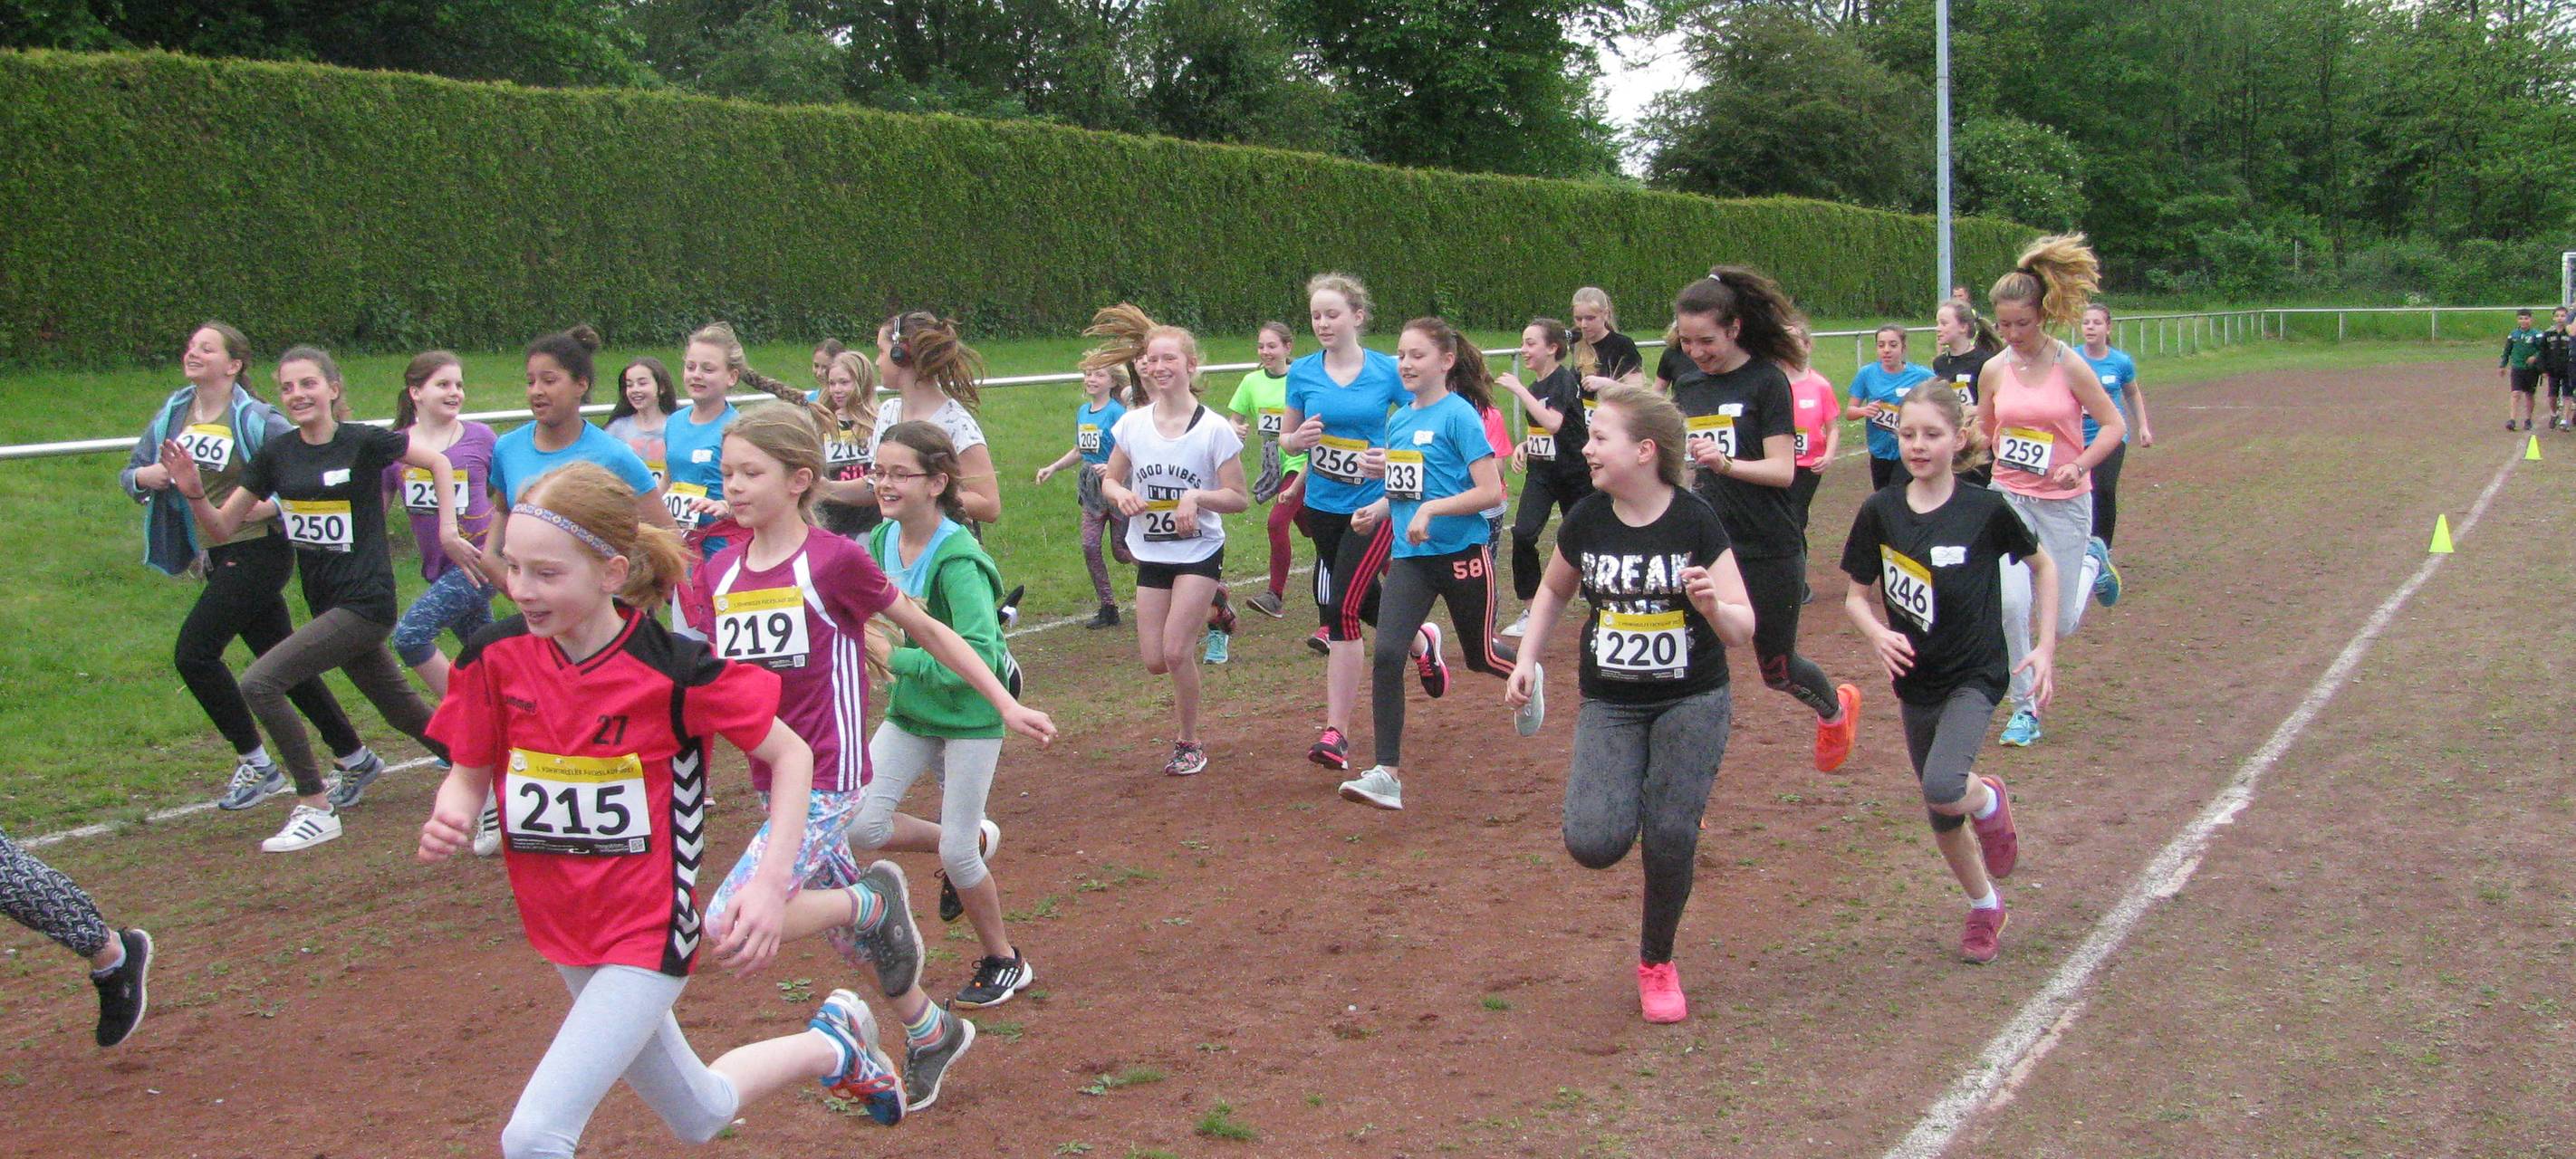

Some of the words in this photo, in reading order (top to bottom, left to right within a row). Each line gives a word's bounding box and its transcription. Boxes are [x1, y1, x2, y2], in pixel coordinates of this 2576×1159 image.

[1263, 415, 1282, 430] 21
[1081, 433, 1098, 447] 205
[1529, 436, 1551, 455] 217
[2004, 438, 2044, 465] 259
[1315, 445, 1359, 474] 256
[1168, 464, 1202, 490] VIBES
[1387, 465, 1416, 490] 233
[291, 513, 344, 541] 250
[1145, 512, 1177, 533] 26
[1452, 558, 1483, 580] 58
[1889, 565, 1927, 614] 246
[723, 612, 793, 657] 219
[1606, 631, 1677, 666] 220
[593, 714, 630, 746] 27
[519, 782, 631, 836] 215
